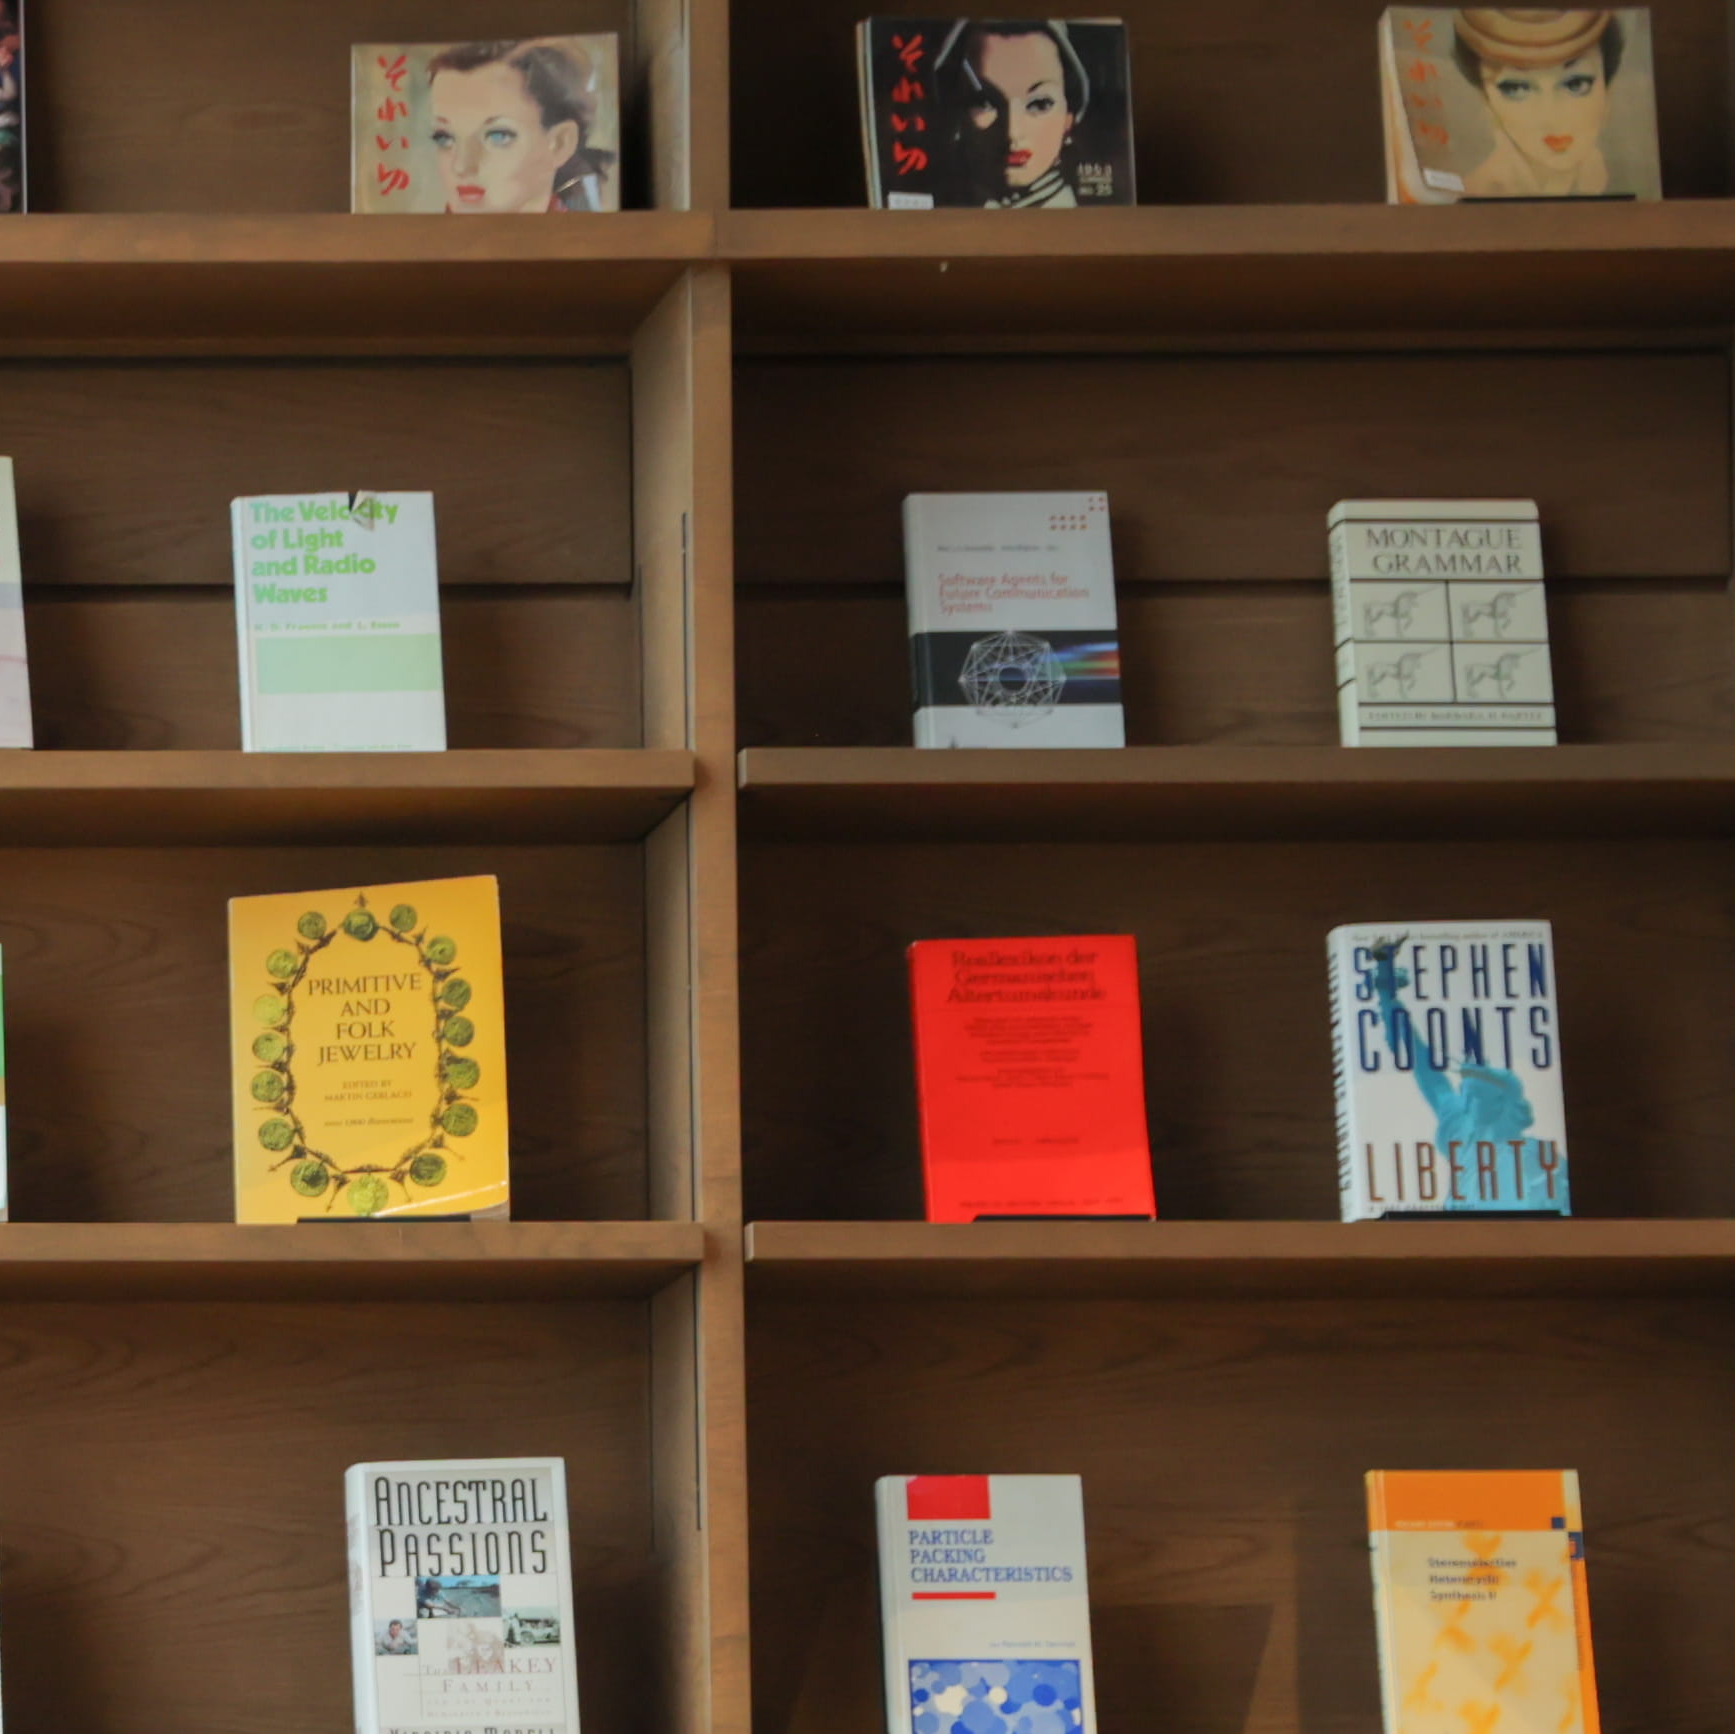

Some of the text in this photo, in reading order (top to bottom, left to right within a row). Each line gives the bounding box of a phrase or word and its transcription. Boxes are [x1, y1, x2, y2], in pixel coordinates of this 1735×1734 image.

[890, 33, 928, 175] それいゆ
[376, 54, 410, 196] それいゆ
[250, 502, 295, 523] The
[251, 528, 344, 552] of Light
[1365, 528, 1523, 548] MONTAGUE
[251, 553, 376, 576] and Radio
[1372, 554, 1523, 574] GRAMMAR
[252, 584, 328, 604] Waves
[1353, 943, 1547, 1001] STEPHEN
[308, 973, 423, 997] PRIMITIVE
[341, 998, 391, 1017] AND
[336, 1020, 395, 1041] FOLK
[1358, 1005, 1552, 1073] COONTS
[317, 1042, 417, 1067] JEWELRY
[1365, 1139, 1559, 1203] LIBERTY
[374, 1476, 548, 1526] ANCESTRAL
[908, 1529, 993, 1545] PARTICLE
[378, 1528, 547, 1578] PASSIONS
[910, 1549, 985, 1564] PACKING
[911, 1566, 1073, 1584] CHARACTERISTICS
[443, 1679, 534, 1693] FAMILY
